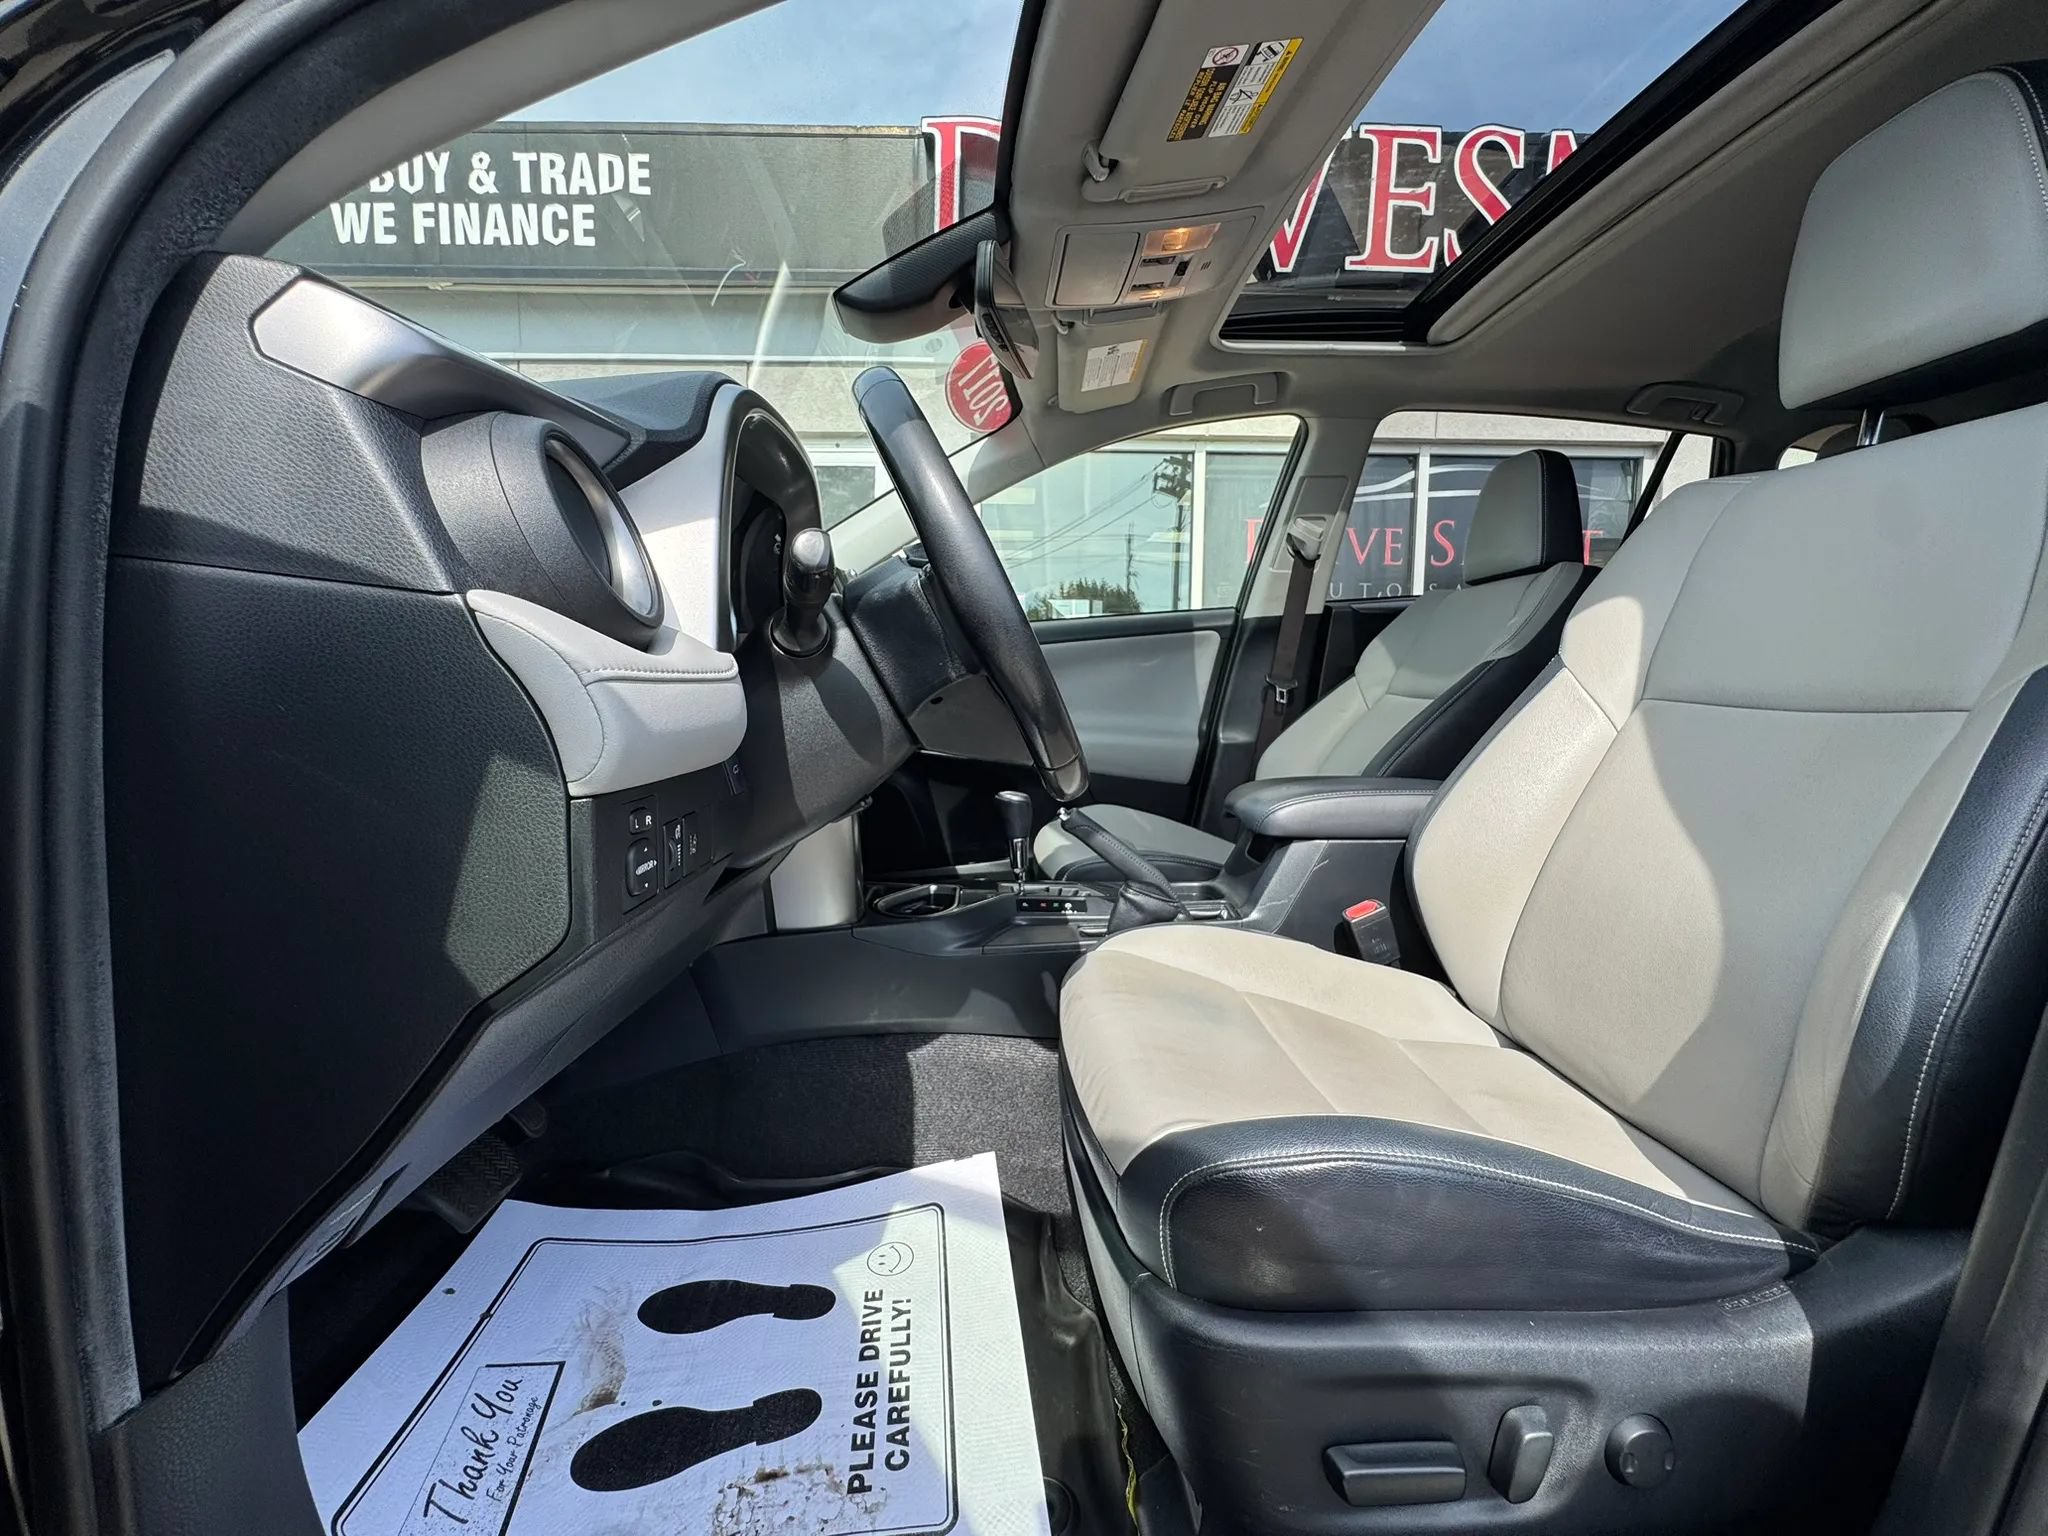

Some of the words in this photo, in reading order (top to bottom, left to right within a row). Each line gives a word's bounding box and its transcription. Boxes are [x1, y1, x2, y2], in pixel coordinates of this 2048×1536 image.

[468, 150, 500, 195] &
[512, 151, 651, 196] TRADE
[329, 202, 397, 245] WE
[412, 202, 596, 247] FINANCE
[645, 815, 652, 825] R
[858, 1289, 884, 1362] DRIVE
[884, 1298, 912, 1472] CAREFULLY!
[507, 1396, 543, 1447] Patronage
[847, 1371, 879, 1494] PLEASE
[423, 1426, 499, 1524] Thank
[495, 1449, 518, 1477] Your
[486, 1479, 507, 1502] For
